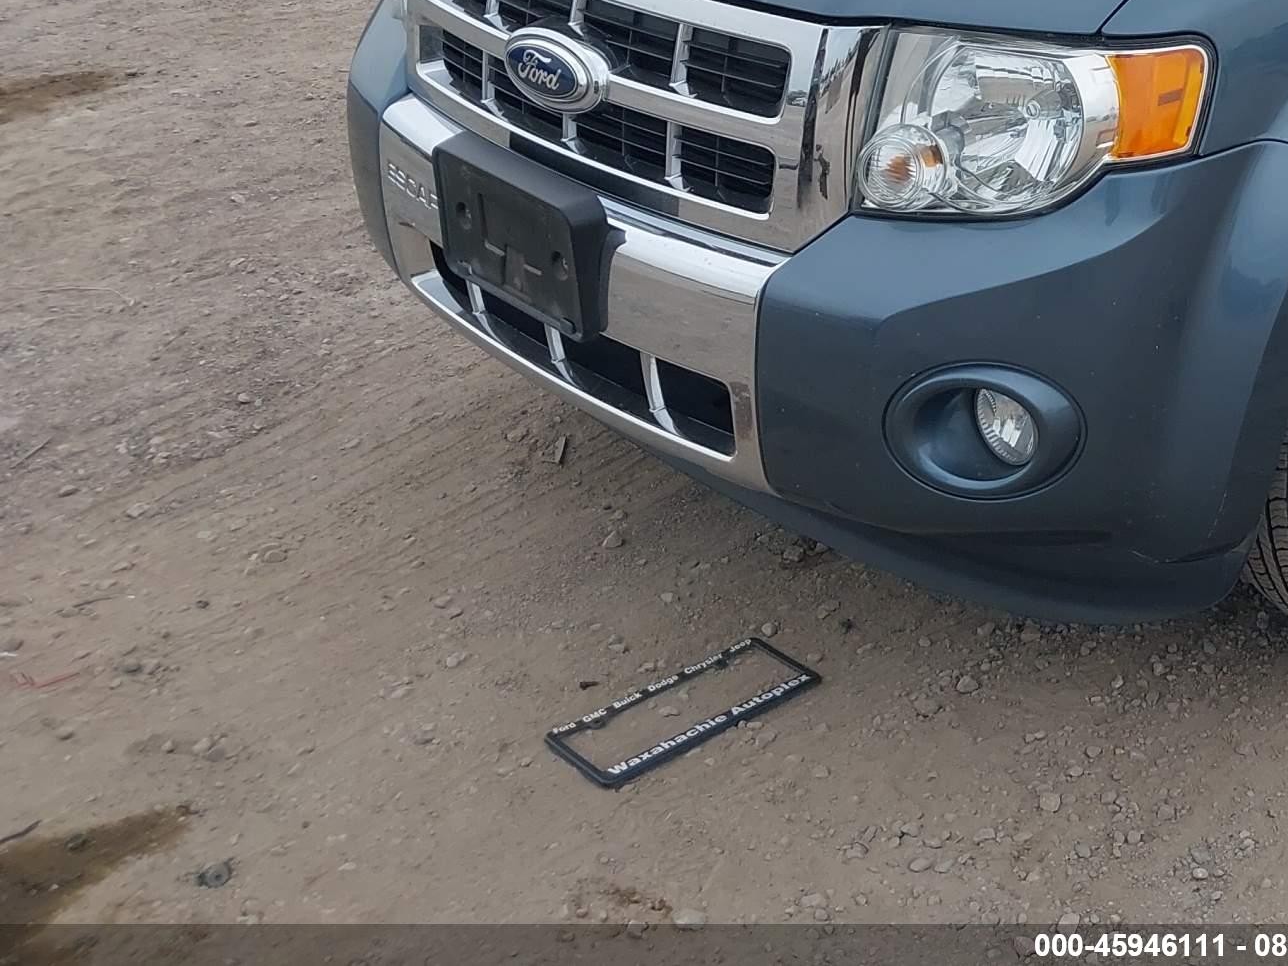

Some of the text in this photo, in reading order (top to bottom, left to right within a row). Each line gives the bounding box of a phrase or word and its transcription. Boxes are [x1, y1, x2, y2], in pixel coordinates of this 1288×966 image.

[517, 49, 562, 91] Ford
[552, 638, 752, 734] Ford GMC Buick Dodge Chrysler Jeep
[607, 674, 811, 774] Waxahachie Autoplex
